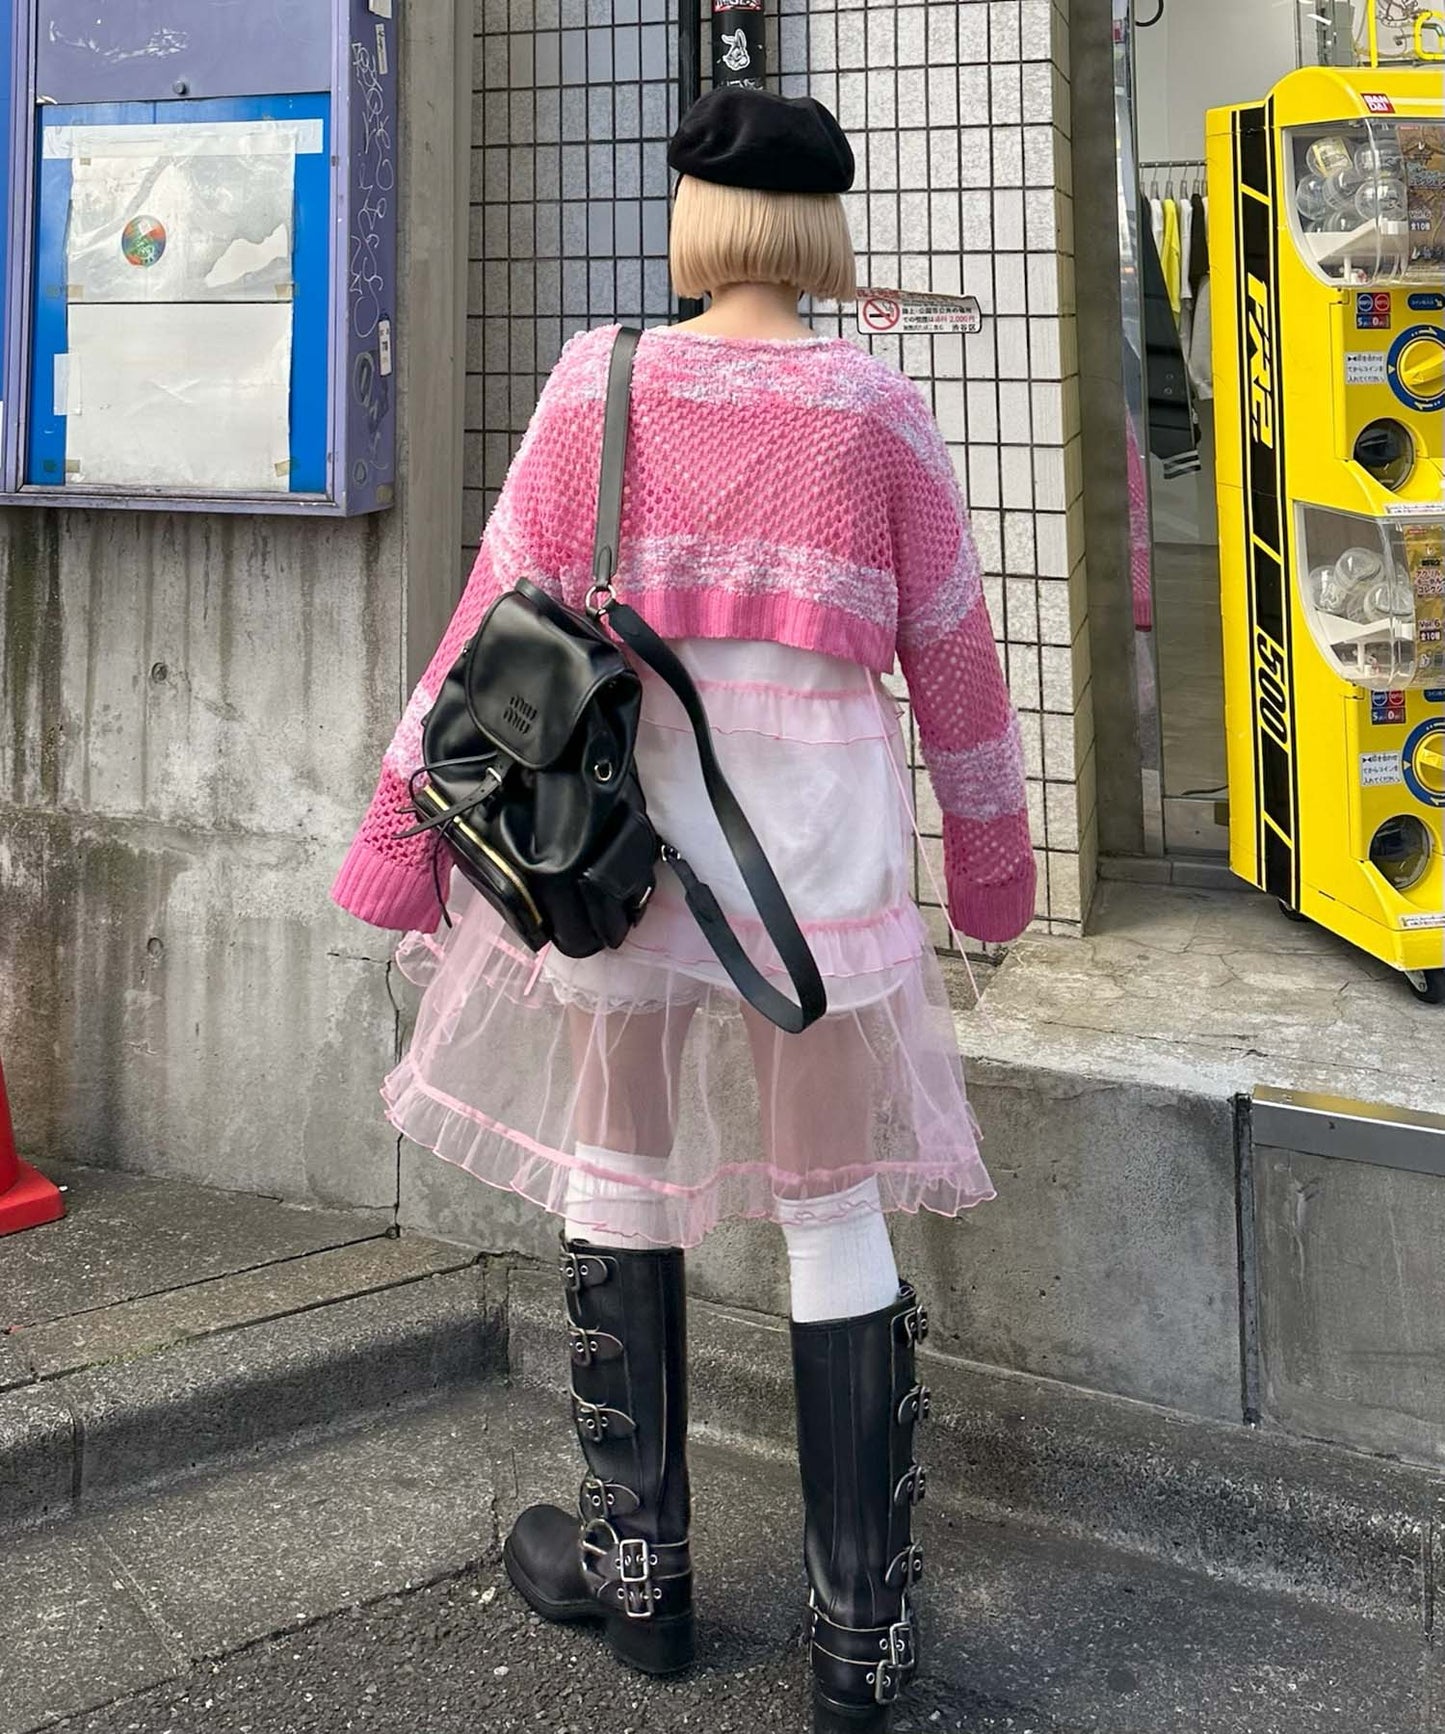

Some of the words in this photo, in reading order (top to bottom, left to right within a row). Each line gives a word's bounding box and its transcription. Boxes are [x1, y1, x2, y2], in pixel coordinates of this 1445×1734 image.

[1363, 94, 1390, 104] BAN
[1368, 102, 1391, 112] DAI
[1256, 632, 1288, 745] 500
